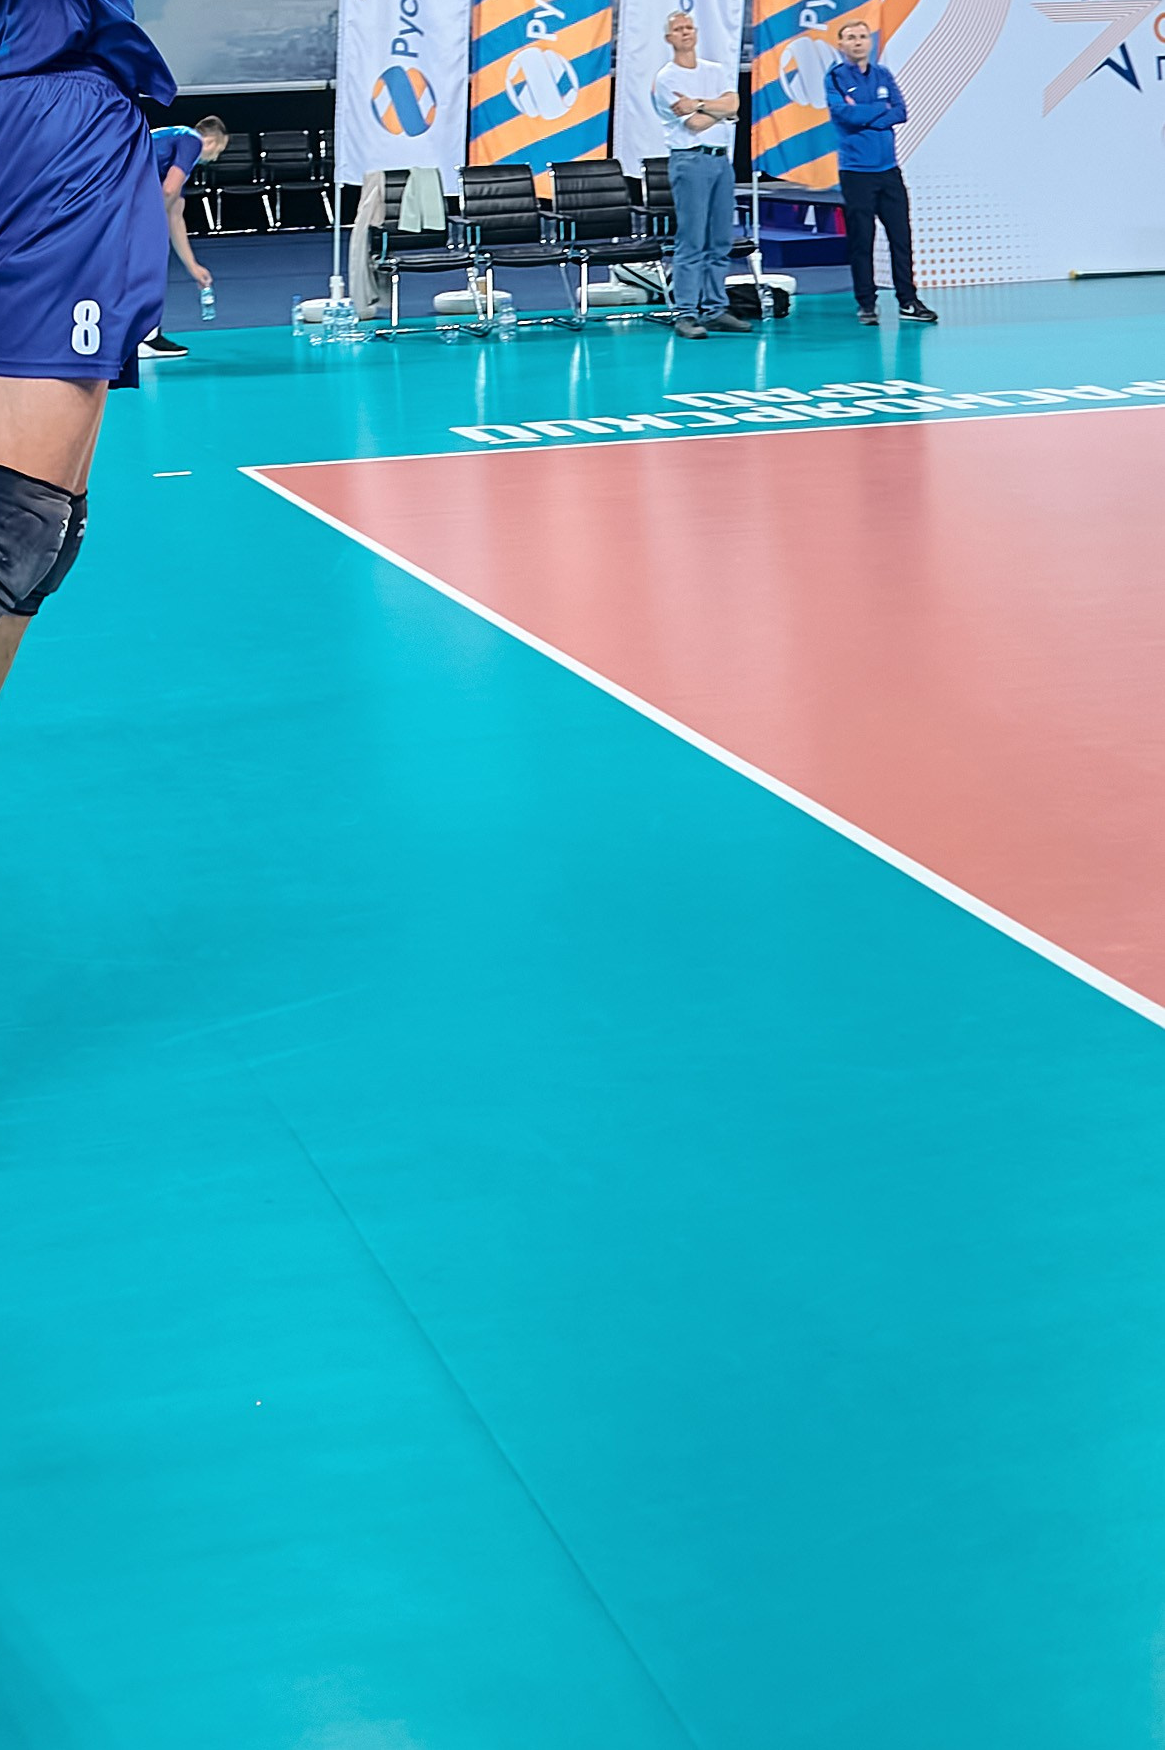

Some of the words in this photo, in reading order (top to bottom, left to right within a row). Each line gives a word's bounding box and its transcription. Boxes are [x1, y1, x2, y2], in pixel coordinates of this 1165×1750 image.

[71, 299, 101, 356] 8
[448, 379, 1165, 445] РАСНОЯРСКИЙ
[662, 379, 946, 410] КРАЙ
